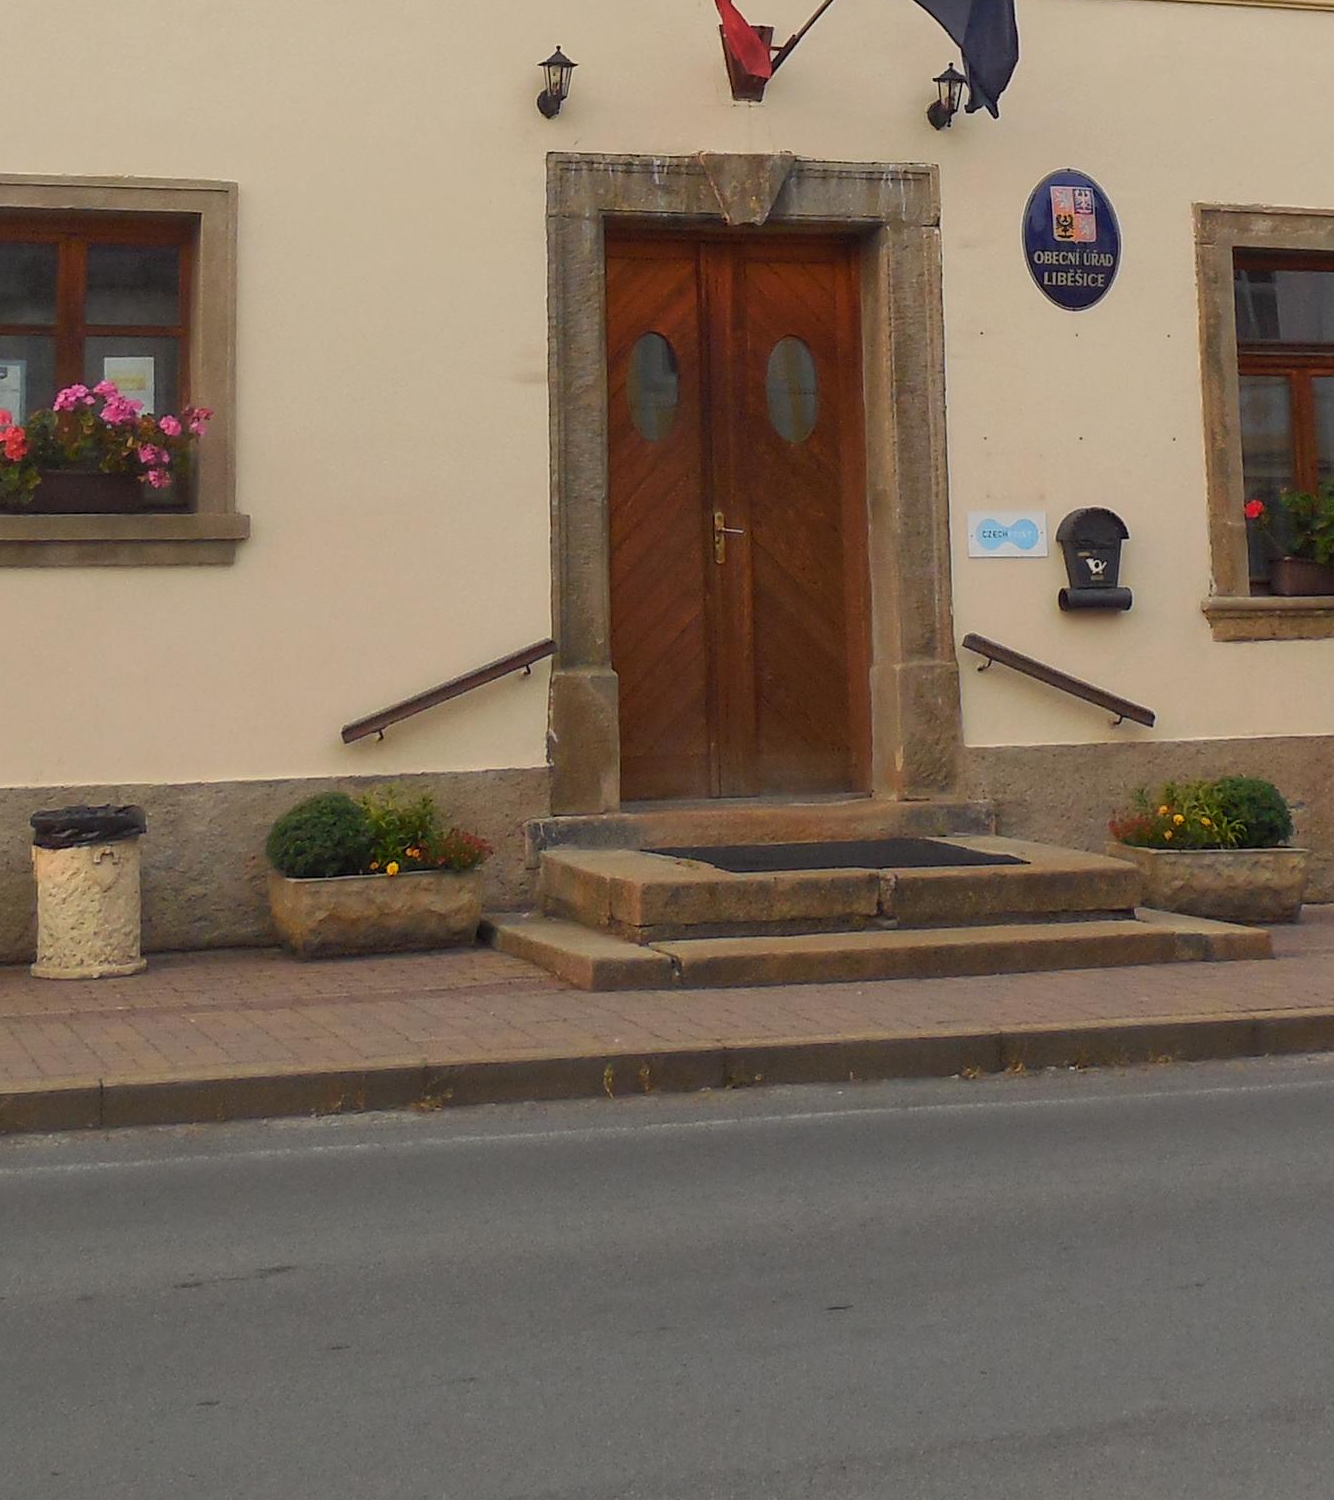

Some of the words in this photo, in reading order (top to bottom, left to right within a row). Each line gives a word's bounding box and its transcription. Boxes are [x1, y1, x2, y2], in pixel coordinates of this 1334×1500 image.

[1033, 249, 1079, 265] OBECNÍ
[1083, 249, 1114, 267] ÚŘAD
[1043, 269, 1105, 287] LIBĚŠICE
[982, 530, 1008, 538] CZECH
